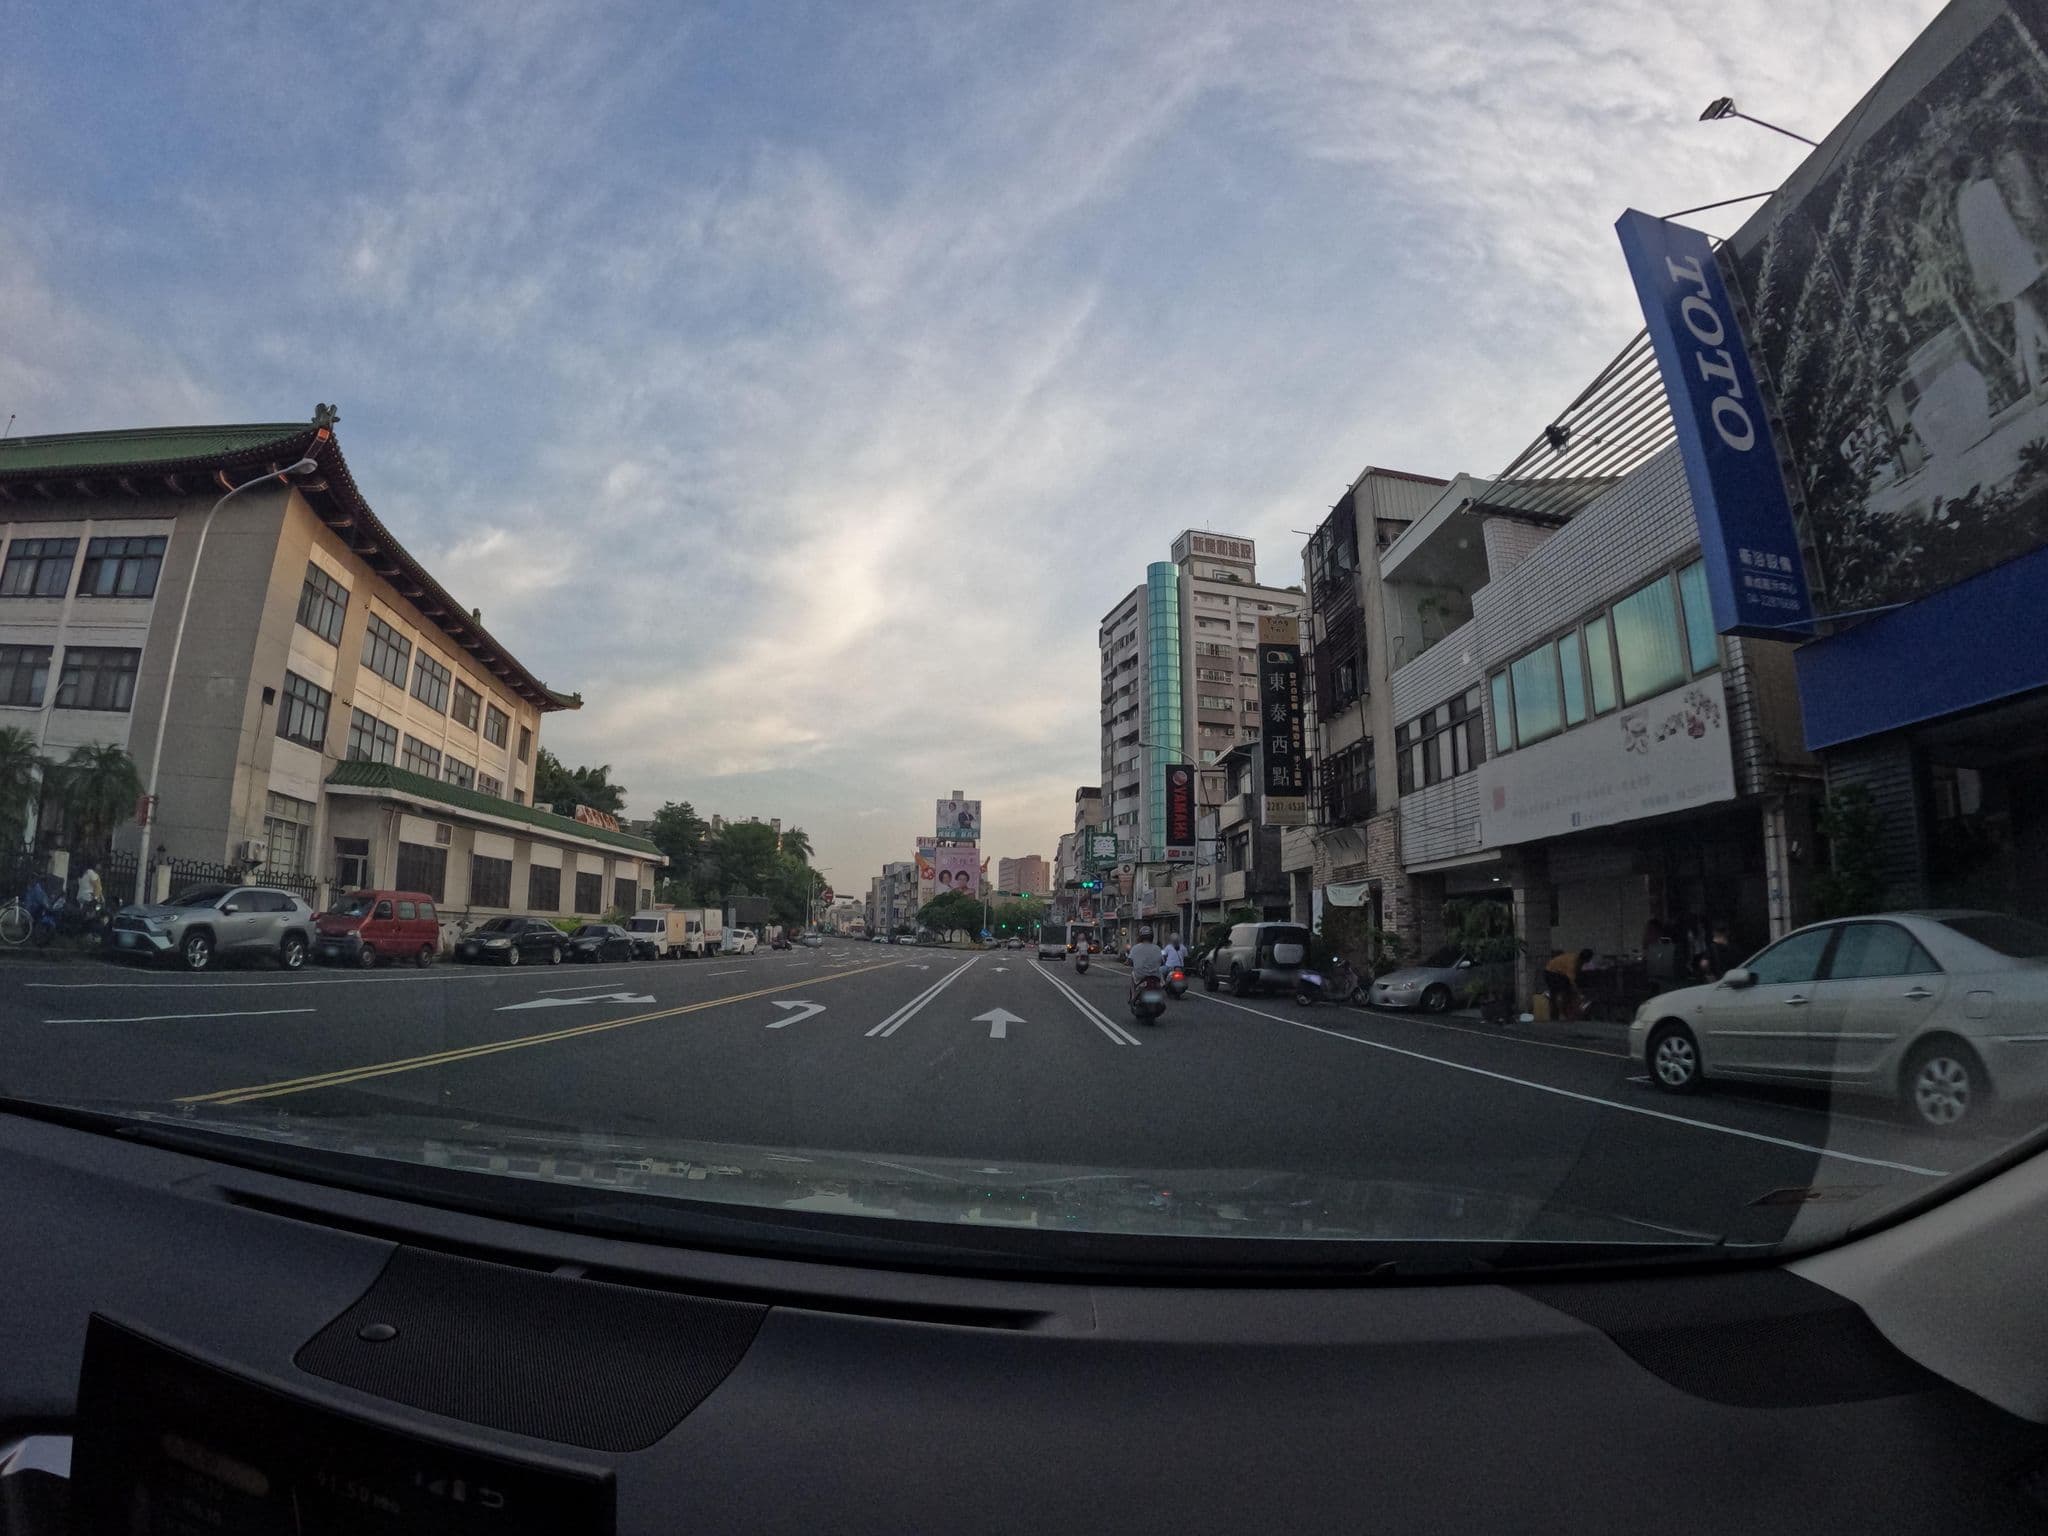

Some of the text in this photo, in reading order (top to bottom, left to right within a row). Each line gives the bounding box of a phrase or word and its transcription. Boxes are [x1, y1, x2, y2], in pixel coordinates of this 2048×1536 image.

[1665, 254, 1755, 453] TOTO
[1268, 671, 1290, 787] 東泰西點
[1173, 785, 1188, 840] YAMAHA
